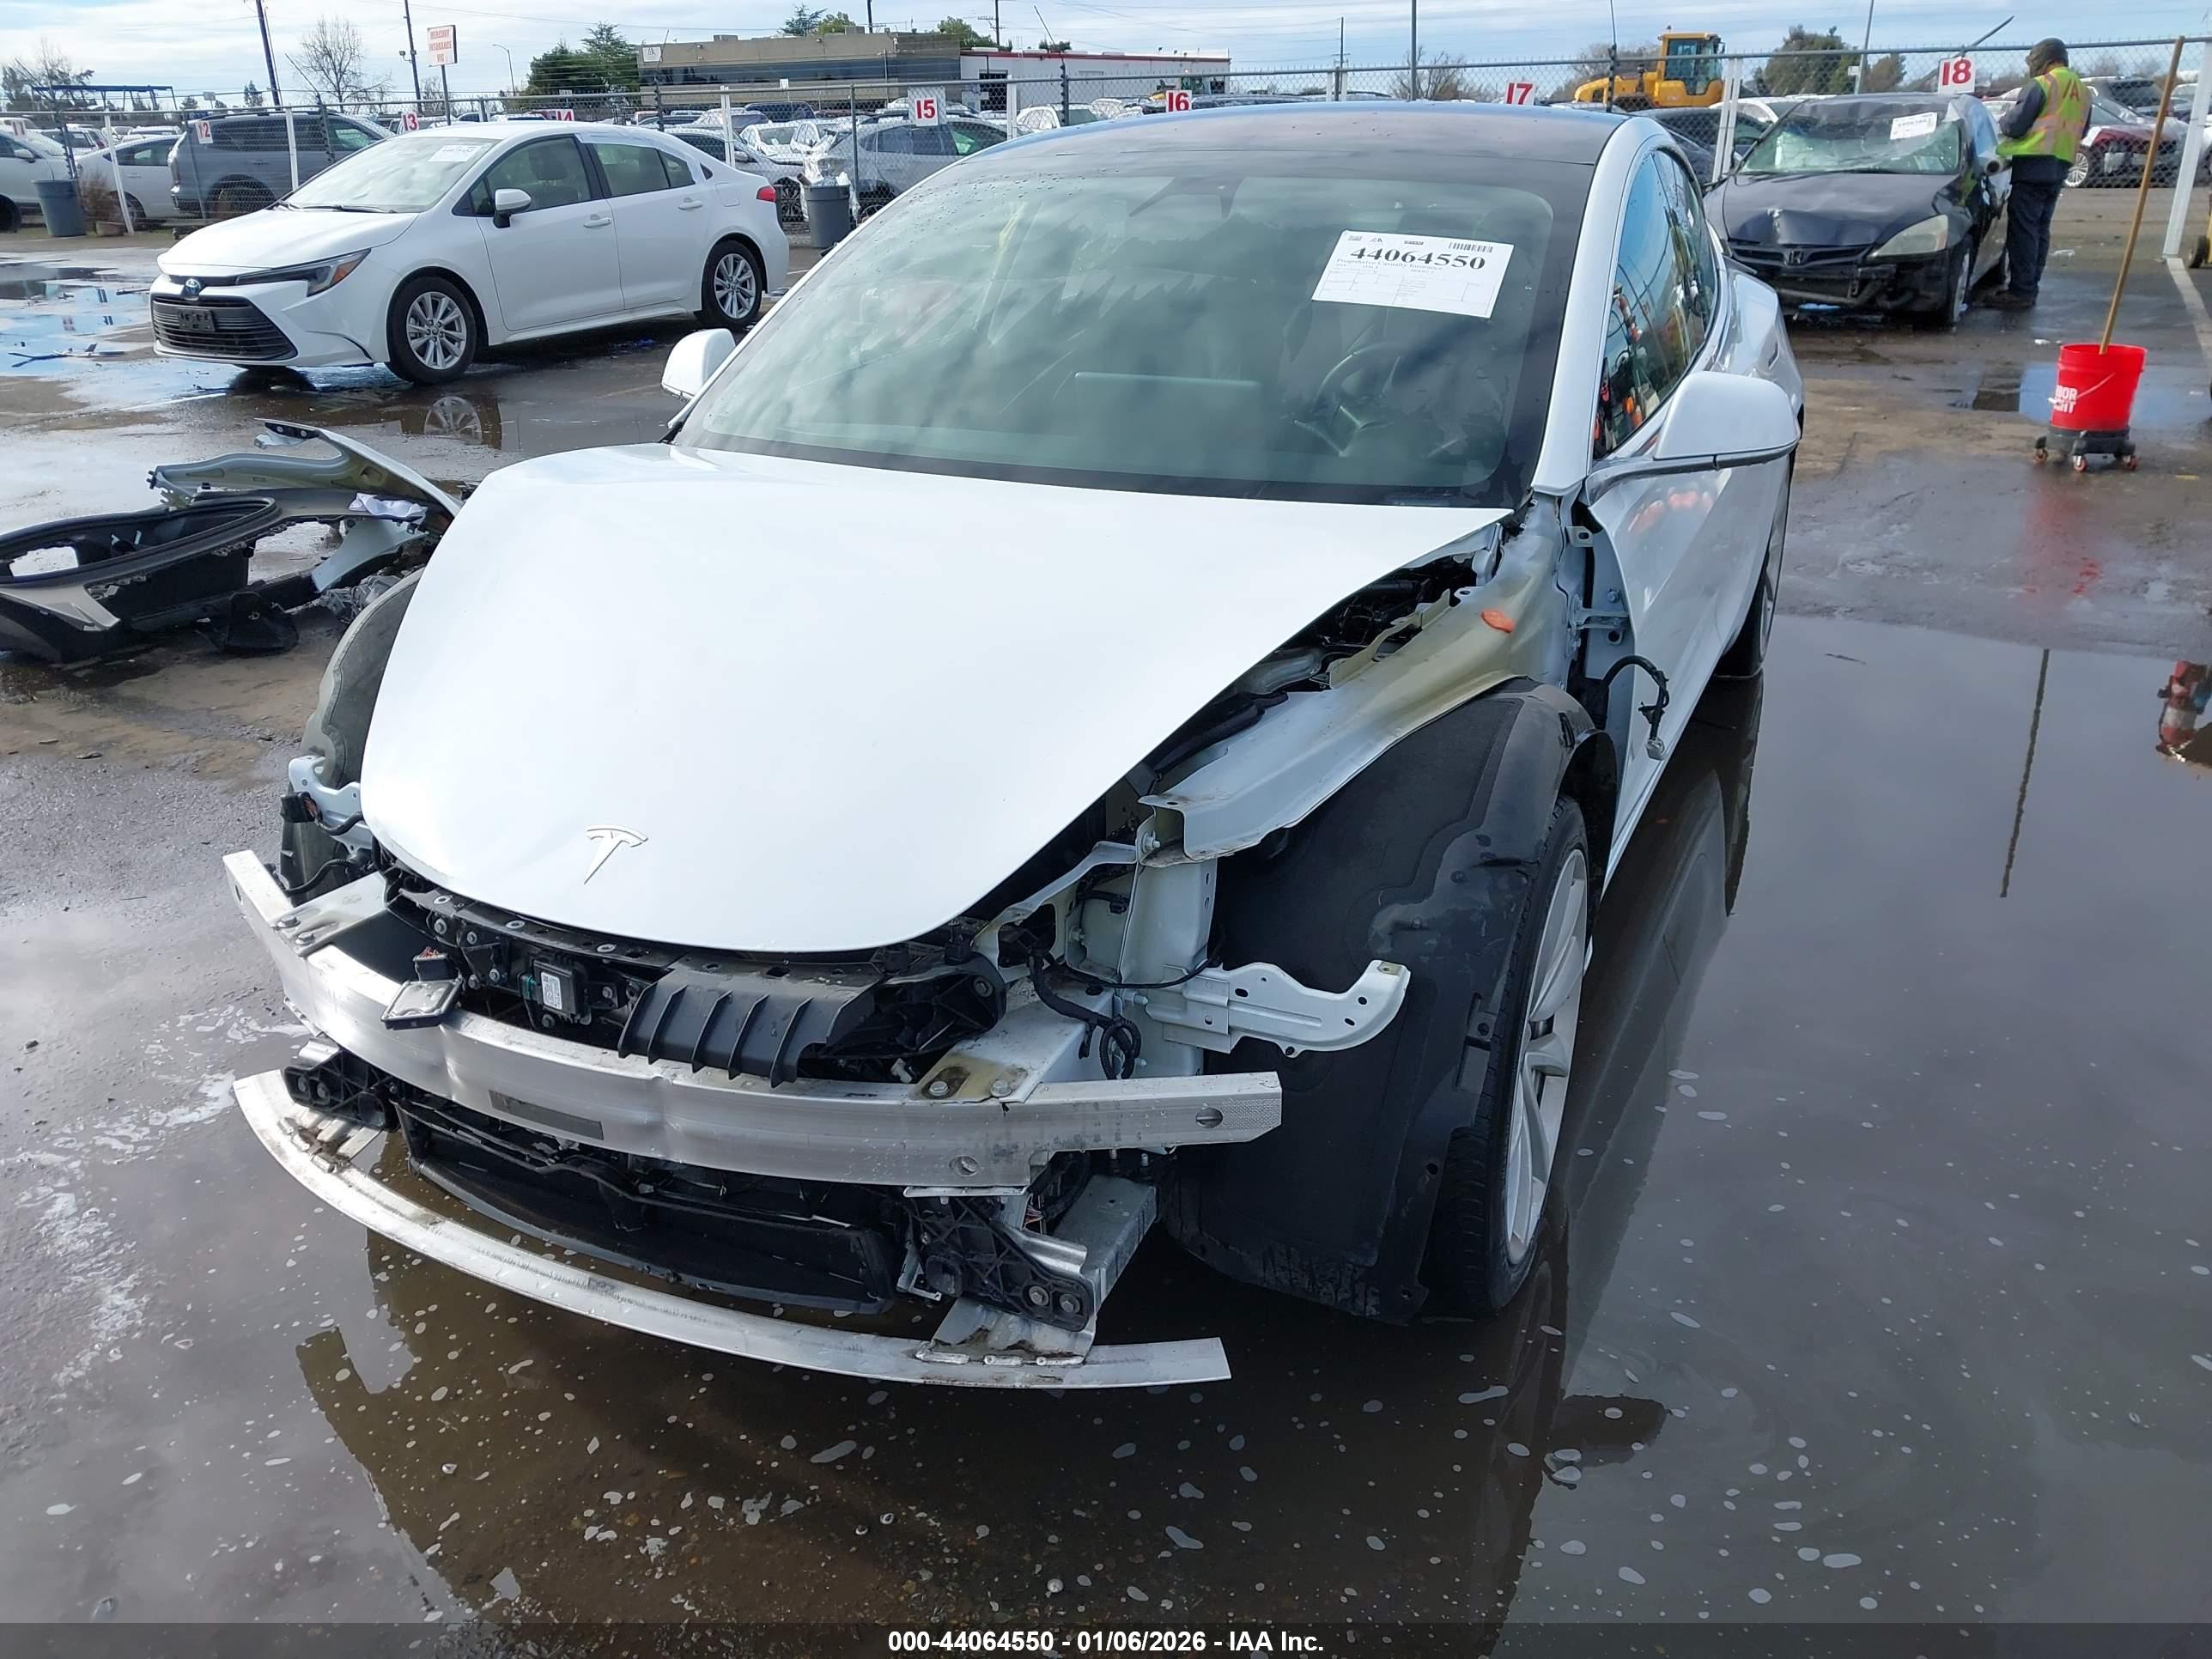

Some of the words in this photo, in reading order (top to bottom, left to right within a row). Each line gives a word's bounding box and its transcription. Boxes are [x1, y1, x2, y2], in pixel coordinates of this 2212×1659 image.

[430, 29, 449, 40] MERCURY
[429, 41, 452, 52] INSURANCE
[1942, 59, 1972, 85] 18
[1169, 92, 1189, 112] 16
[1506, 82, 1534, 105] 17
[916, 99, 935, 118] 15
[13, 121, 25, 136] 11
[198, 122, 211, 137] 12
[403, 113, 417, 131] 13
[1350, 246, 1486, 270] 44064550
